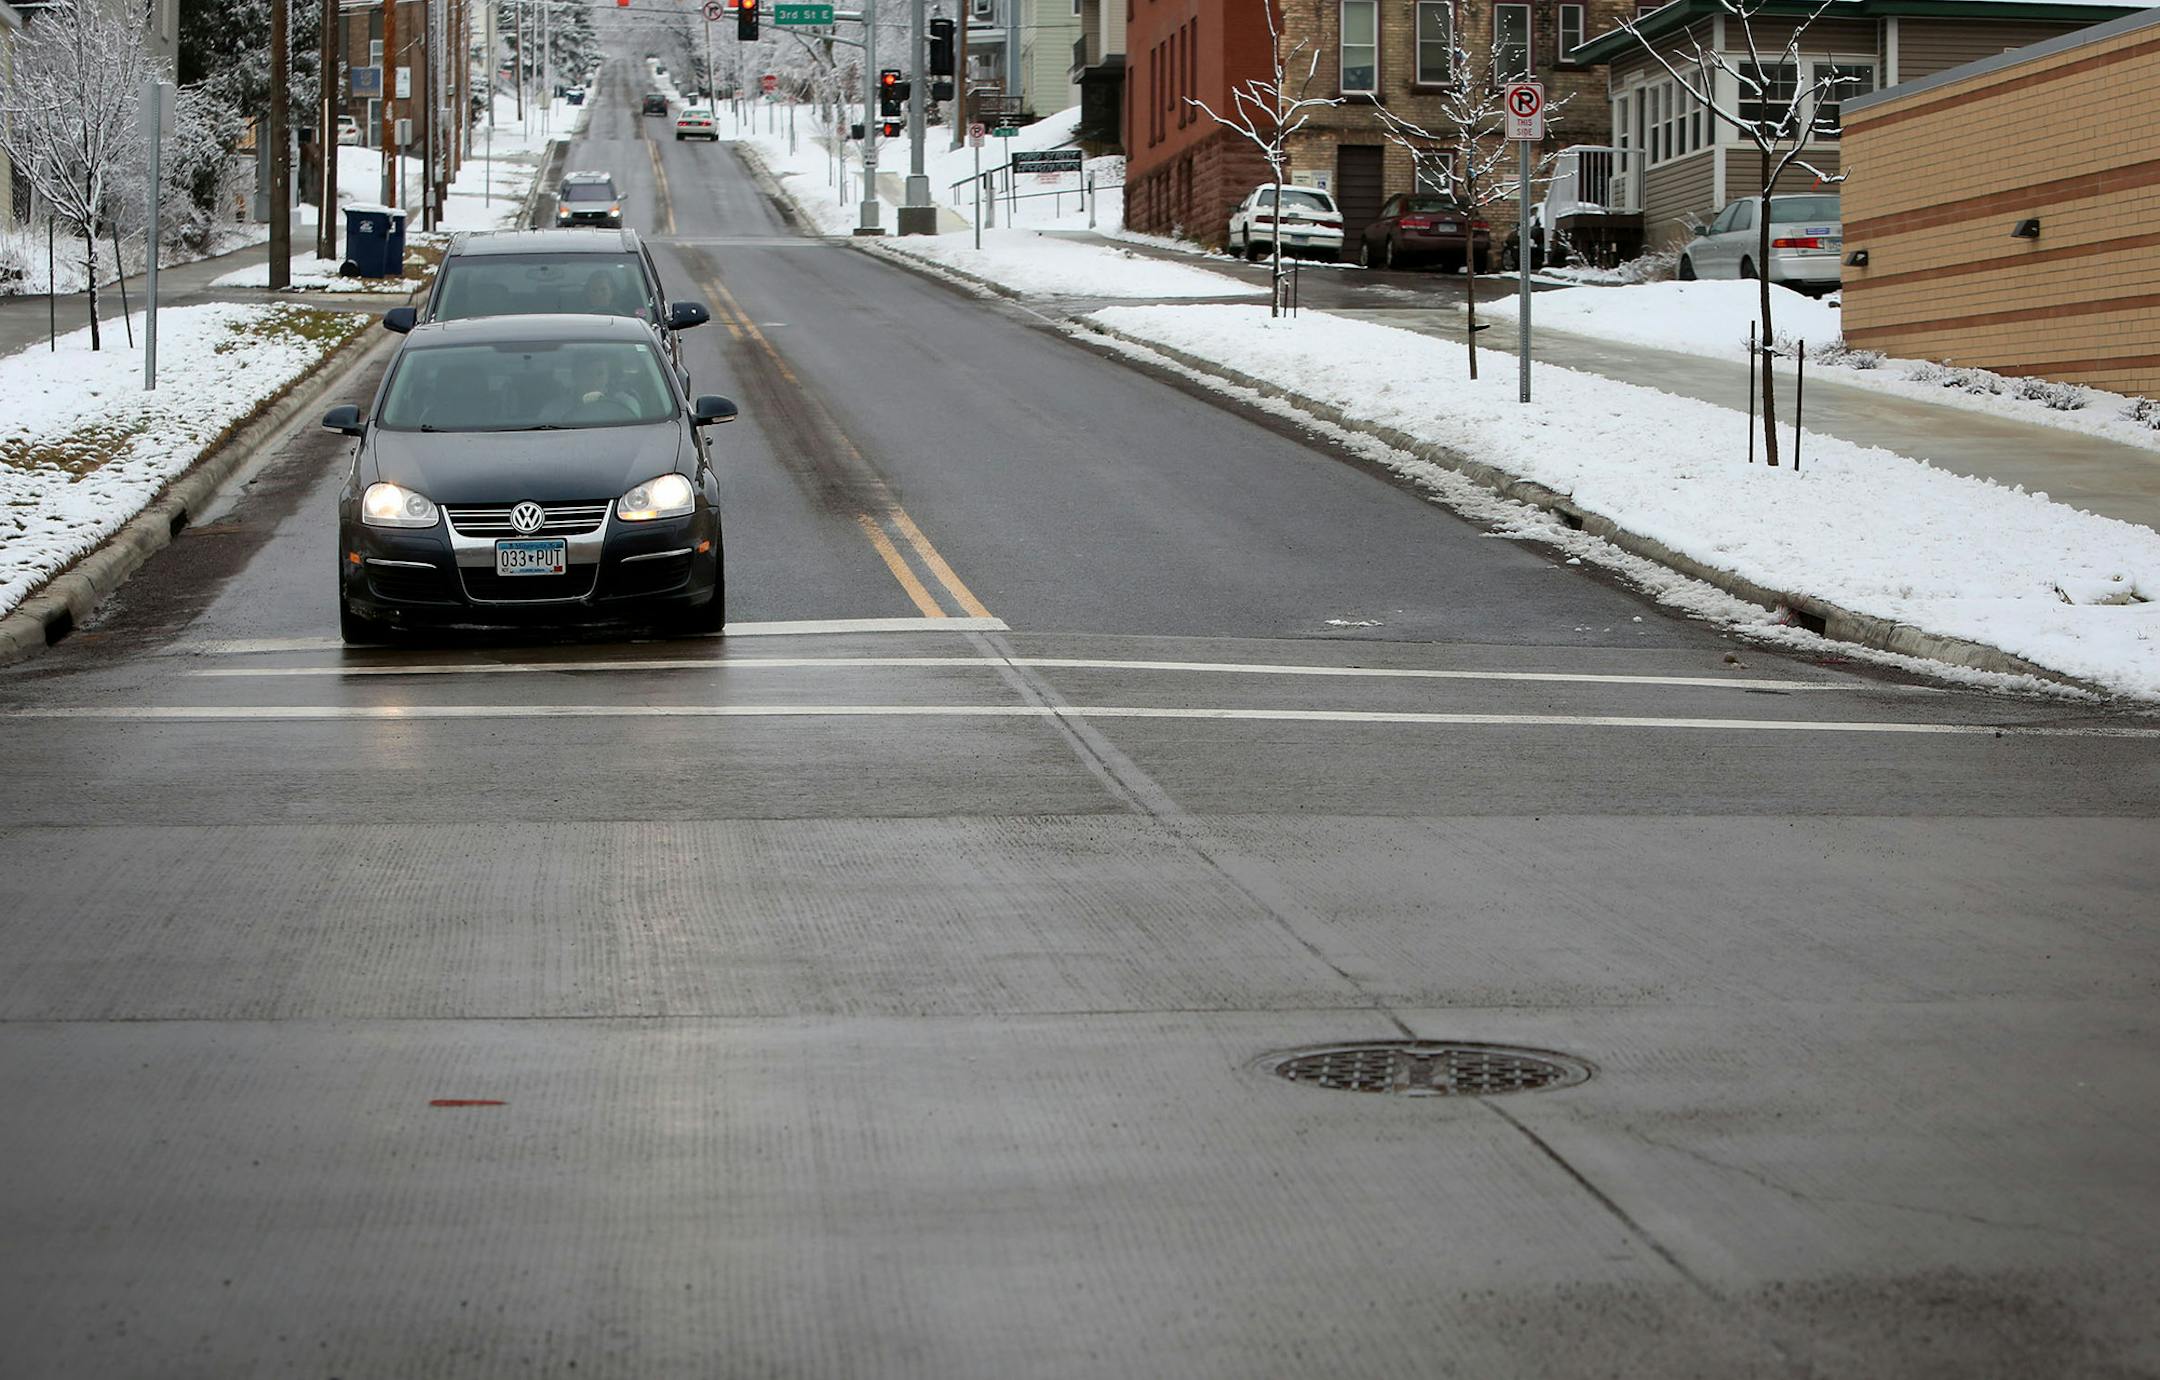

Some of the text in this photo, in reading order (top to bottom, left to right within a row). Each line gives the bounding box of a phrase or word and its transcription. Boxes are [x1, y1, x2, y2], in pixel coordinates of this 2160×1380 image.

[779, 9, 830, 19] 3rd St E
[1517, 128, 1533, 136] SIDE
[501, 549, 561, 567] 033 PUT
